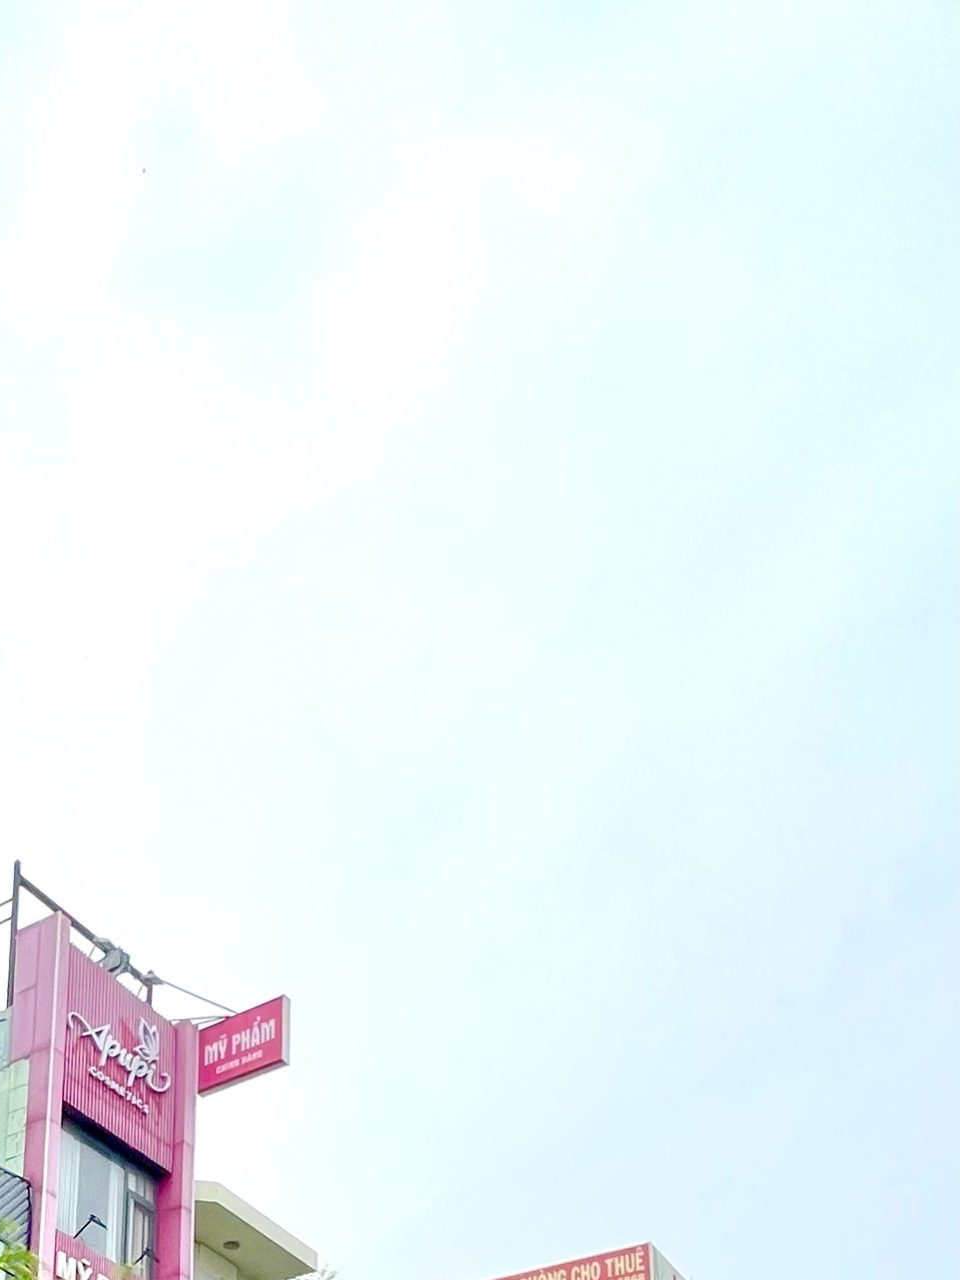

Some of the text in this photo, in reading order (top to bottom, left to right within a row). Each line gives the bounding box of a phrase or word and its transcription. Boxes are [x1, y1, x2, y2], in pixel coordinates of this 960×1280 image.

[68, 1011, 171, 1093] Apupi
[204, 1015, 276, 1067] MỸ PHẨM
[604, 1247, 646, 1277] THUÊ
